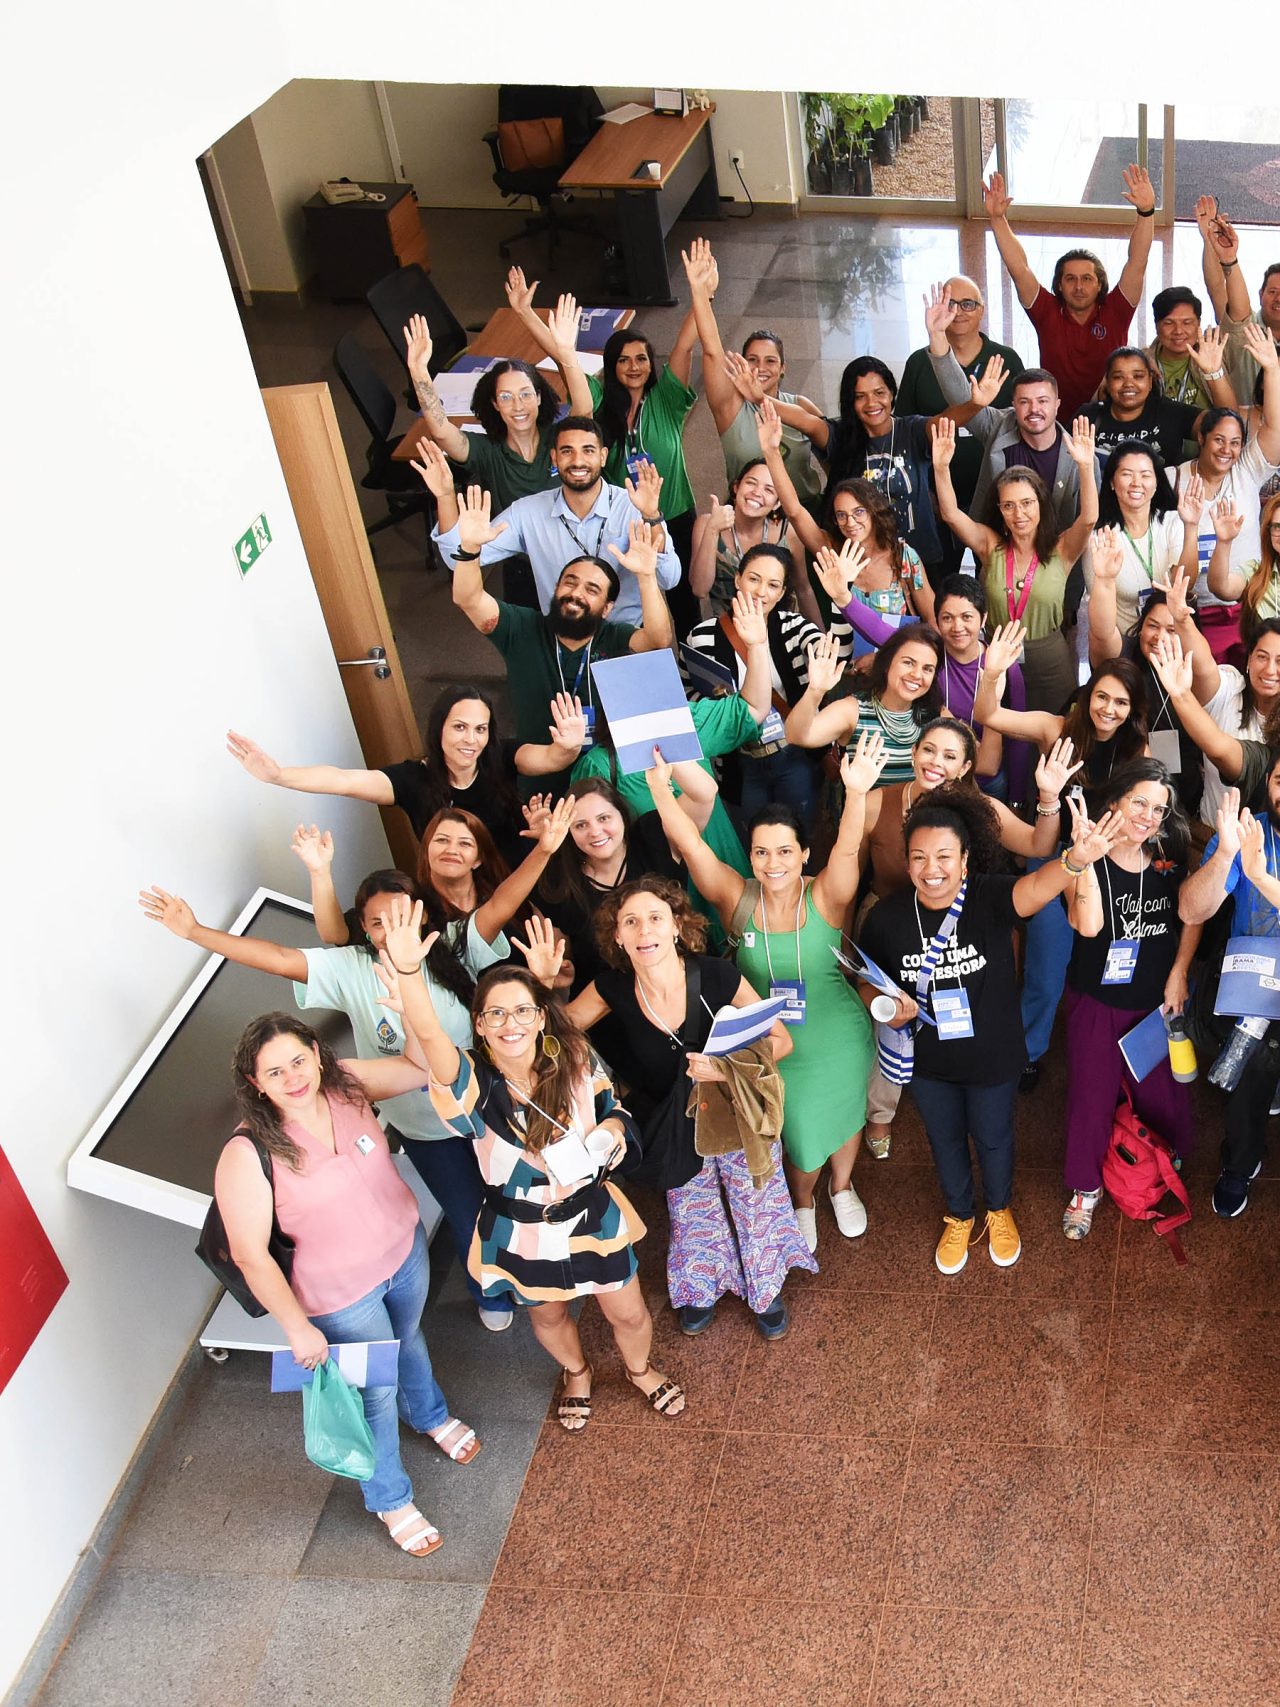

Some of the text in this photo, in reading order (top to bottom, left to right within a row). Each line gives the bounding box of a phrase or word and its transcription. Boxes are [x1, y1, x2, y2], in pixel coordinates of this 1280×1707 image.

[1115, 893, 1171, 914] Vai com
[945, 944, 978, 963] UMA
[900, 955, 987, 982] PRESSORA
